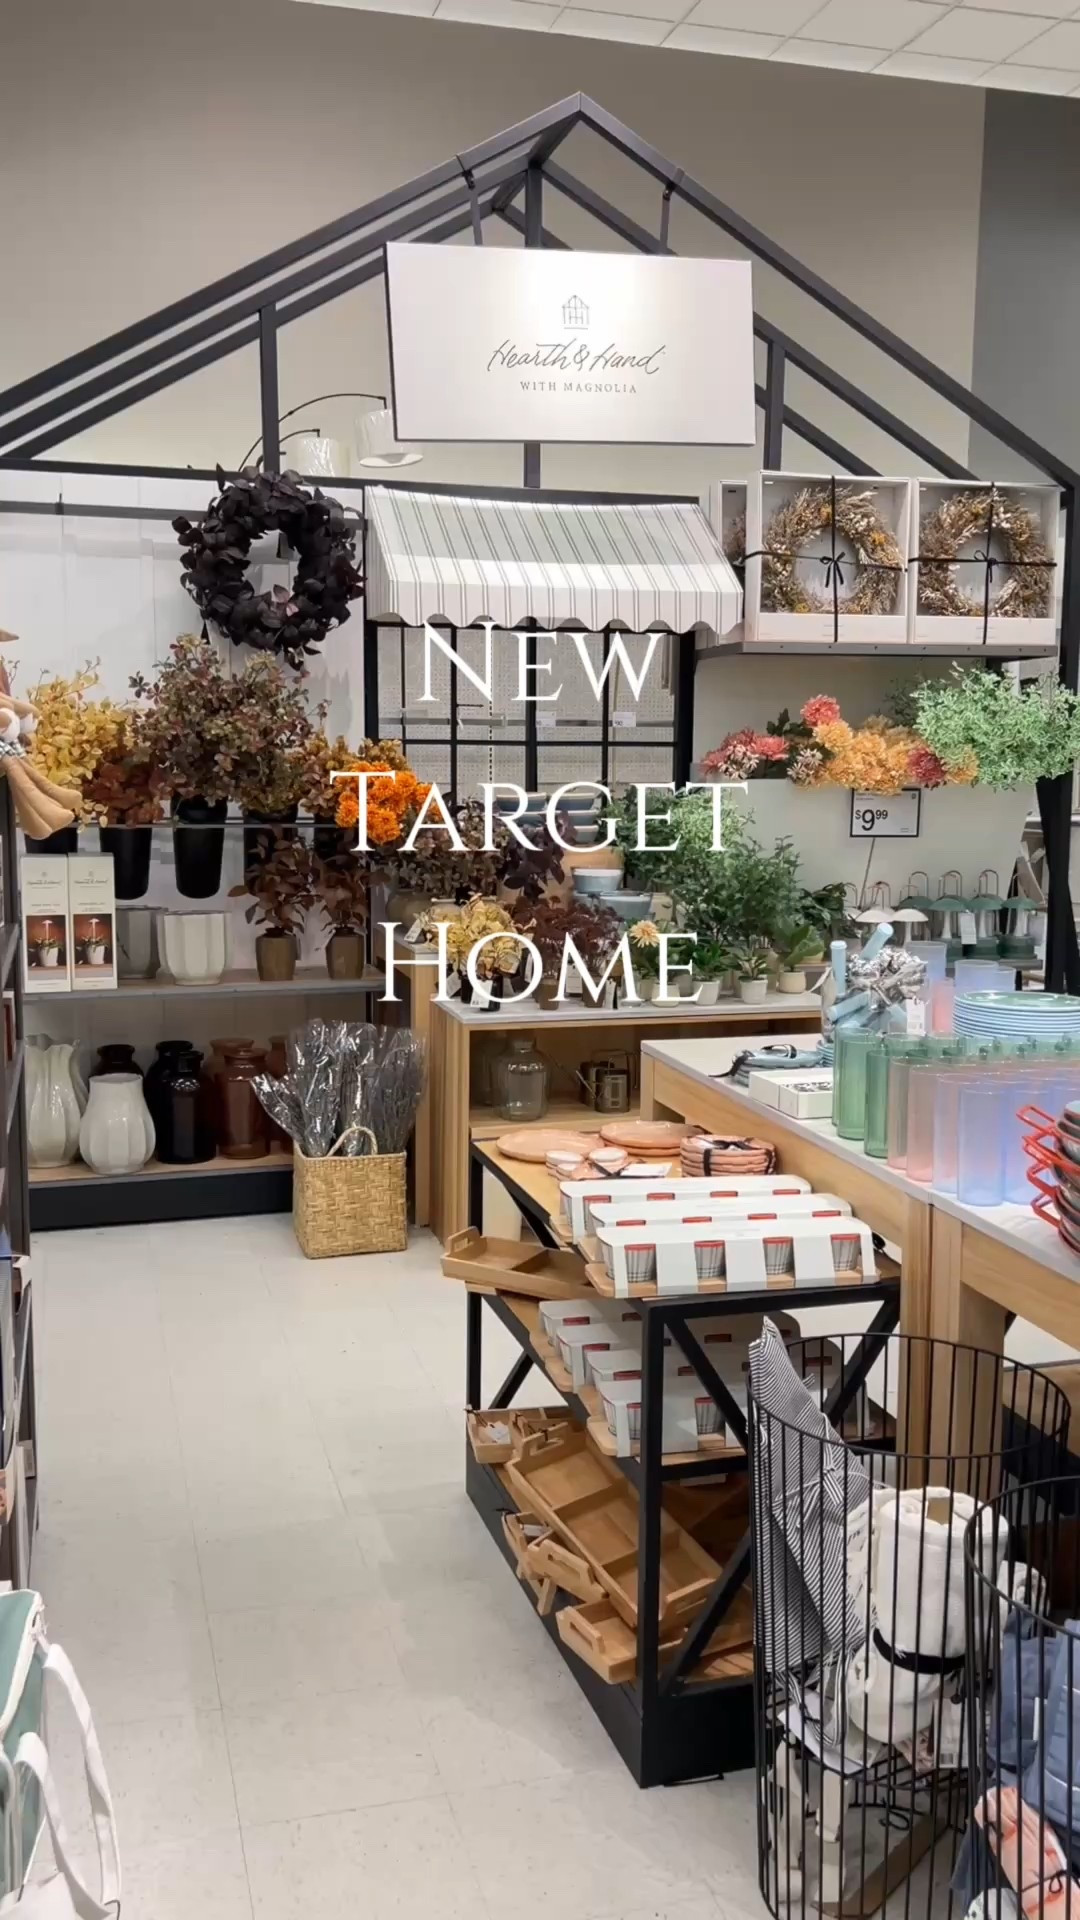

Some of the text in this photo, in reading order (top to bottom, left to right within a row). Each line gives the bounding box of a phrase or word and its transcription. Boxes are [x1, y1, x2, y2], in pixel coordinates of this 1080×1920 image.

[487, 337, 666, 375] Hearth & Hand
[520, 381, 637, 394] WITH MAGNOLIA
